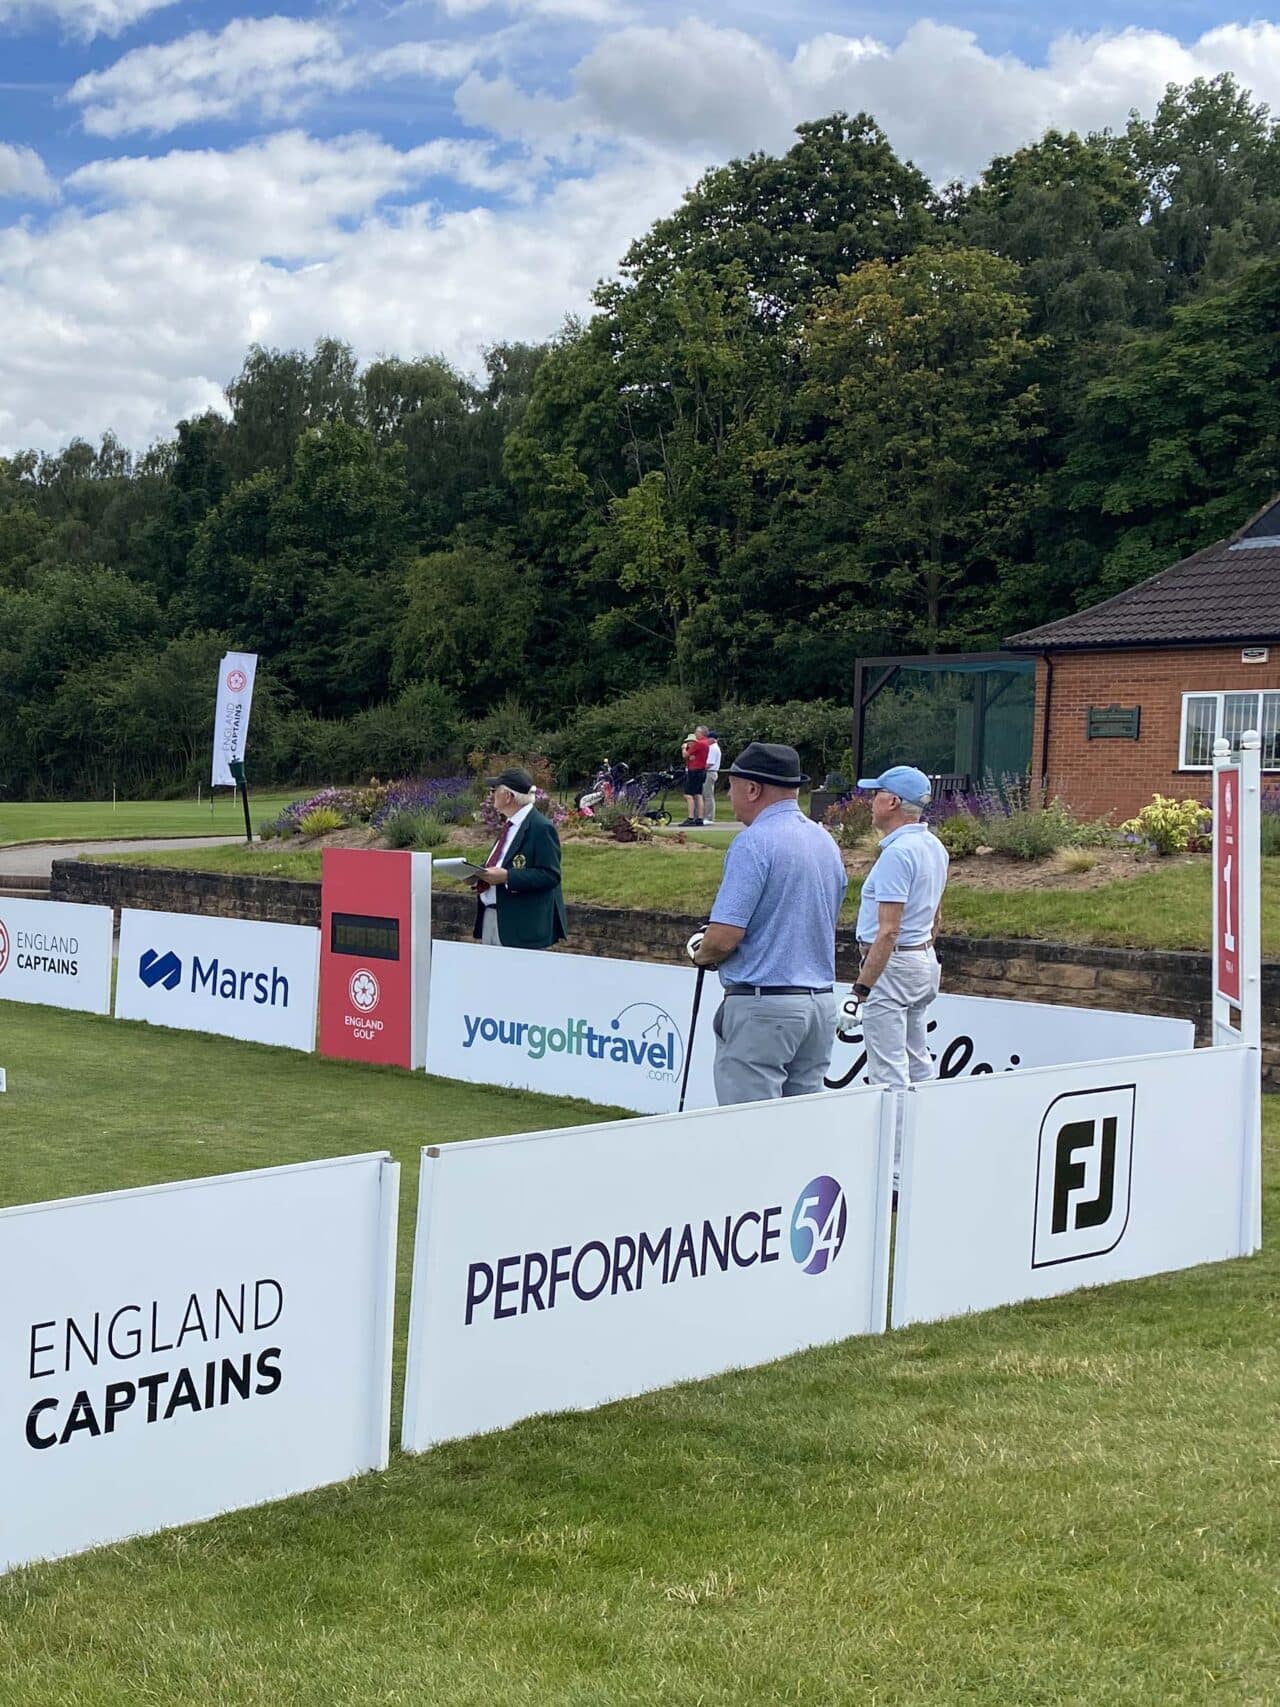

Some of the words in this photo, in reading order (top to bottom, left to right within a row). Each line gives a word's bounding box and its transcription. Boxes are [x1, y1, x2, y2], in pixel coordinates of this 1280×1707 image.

[224, 702, 235, 751] ENGLAND
[231, 703, 243, 752] CAPTAINS
[17, 931, 79, 955] ENGLAND
[17, 953, 78, 976] CAPTAINS
[191, 956, 289, 1007] Marsh
[344, 1015, 384, 1031] ENGLAND
[353, 1028, 376, 1040] GOLF
[462, 1014, 674, 1071] yourgolftravel
[1051, 1116, 1118, 1234] FJ
[464, 1206, 783, 1326] PERFORMANCE
[28, 1278, 284, 1380] ENGLAND
[25, 1347, 283, 1451] CAPTAINS
